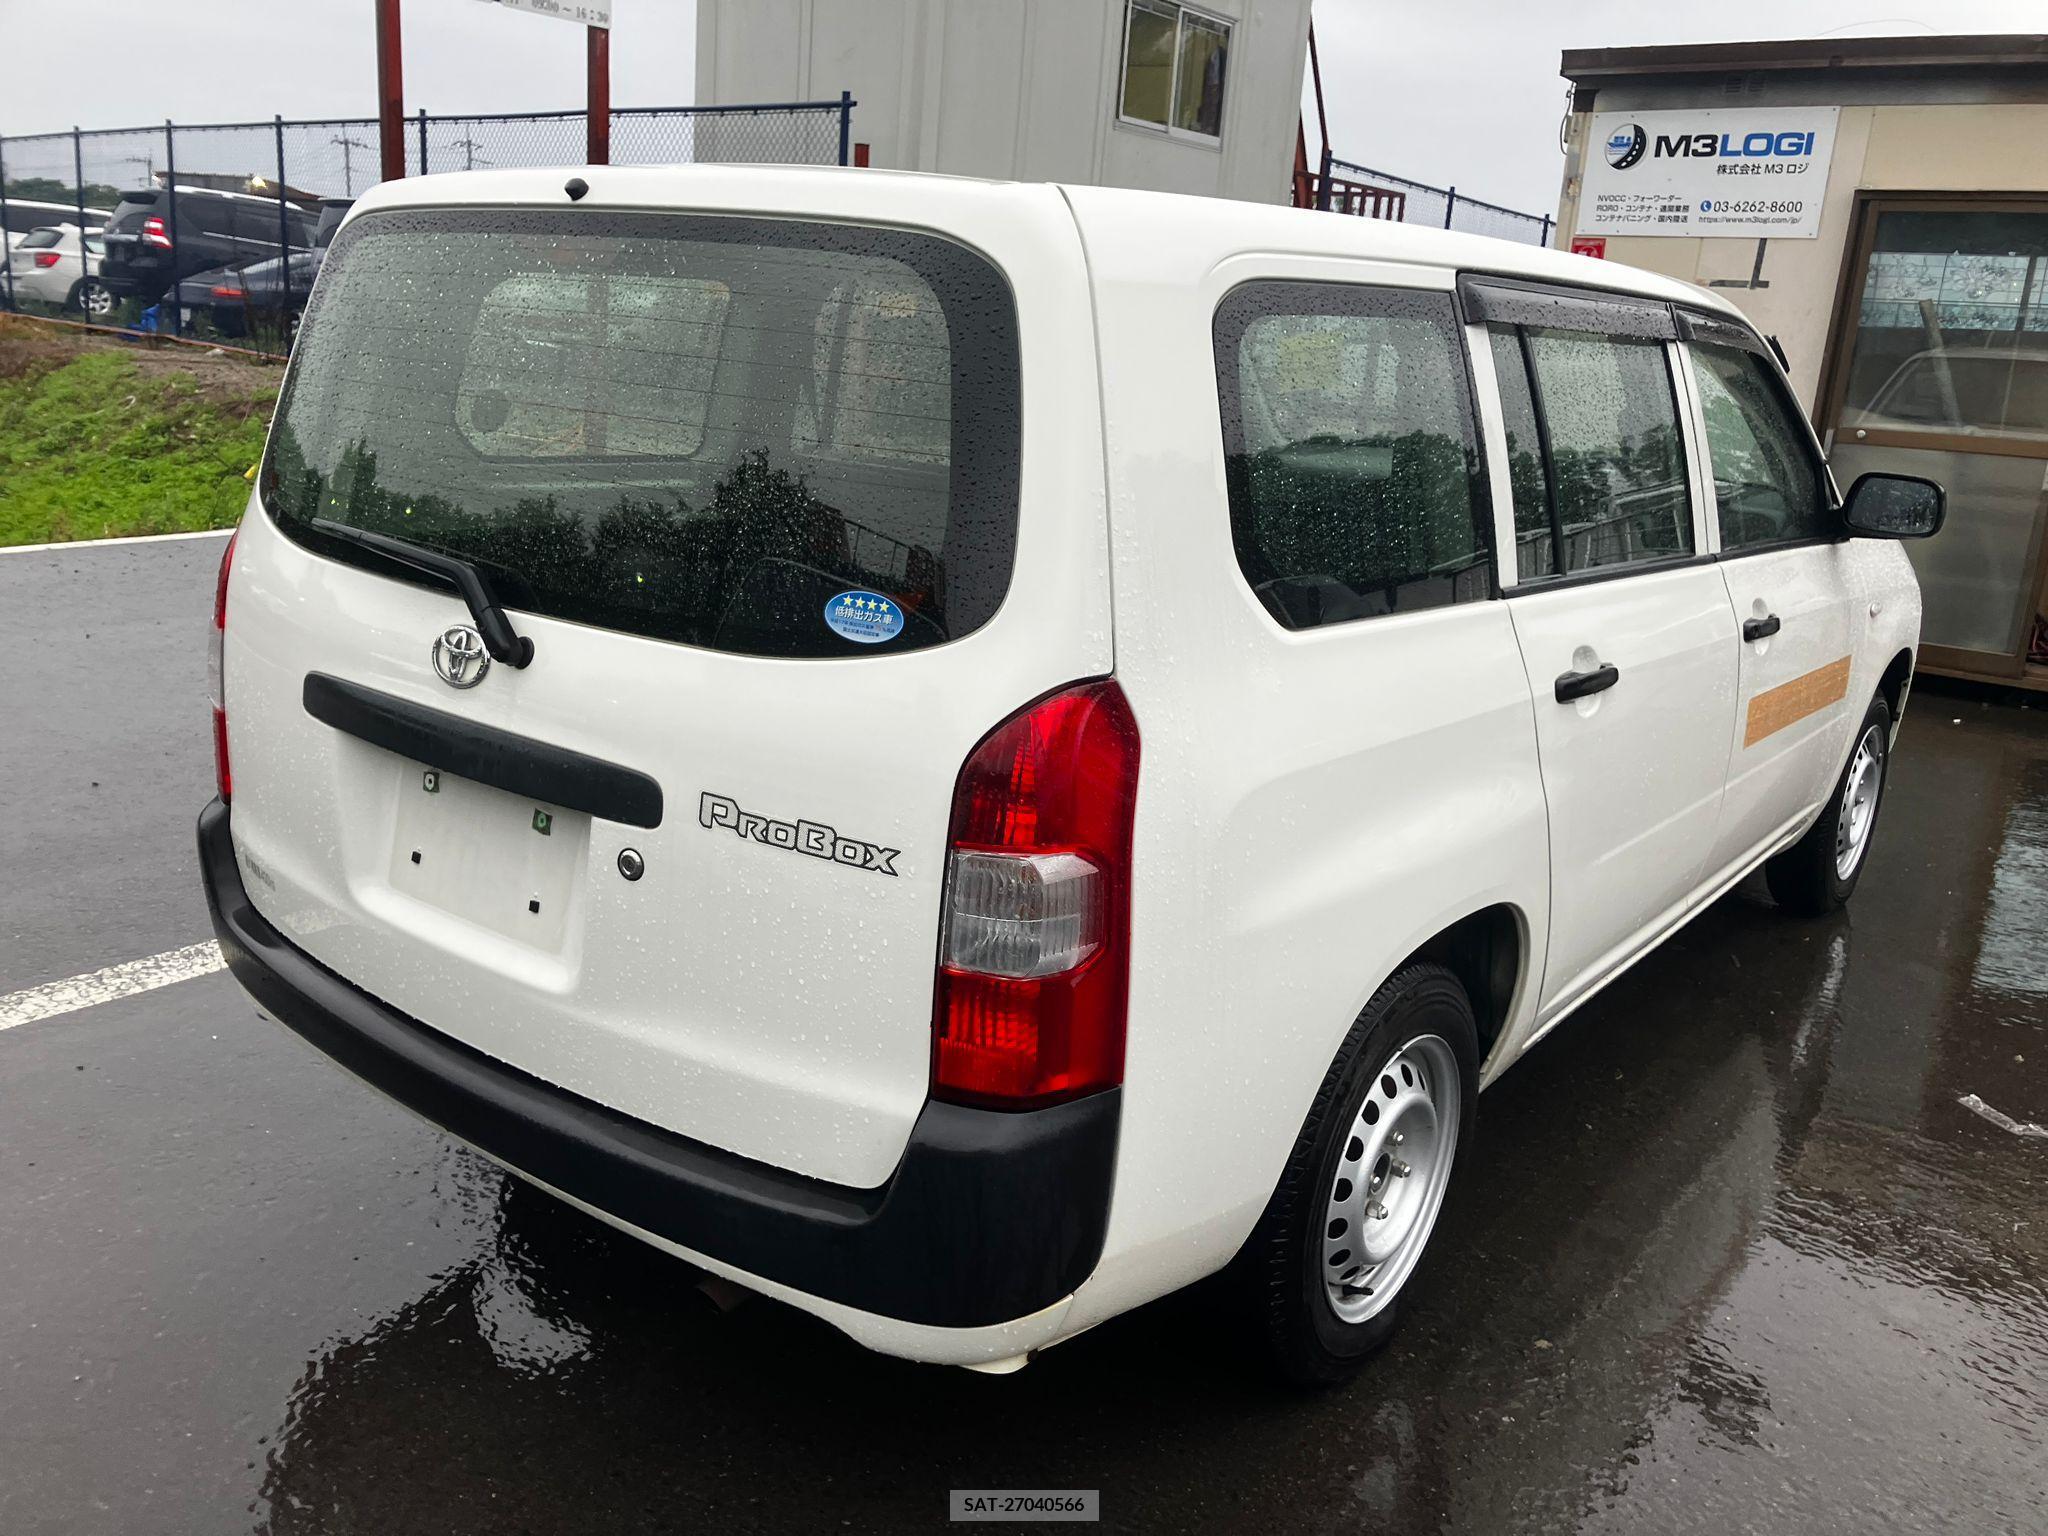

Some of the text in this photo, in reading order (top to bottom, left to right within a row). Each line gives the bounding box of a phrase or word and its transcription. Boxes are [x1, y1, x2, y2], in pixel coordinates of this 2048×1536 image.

[1654, 131, 1815, 158] M3LOGI
[1713, 200, 1803, 213] 03-6262-8600
[835, 605, 894, 625] 低排出ガス車
